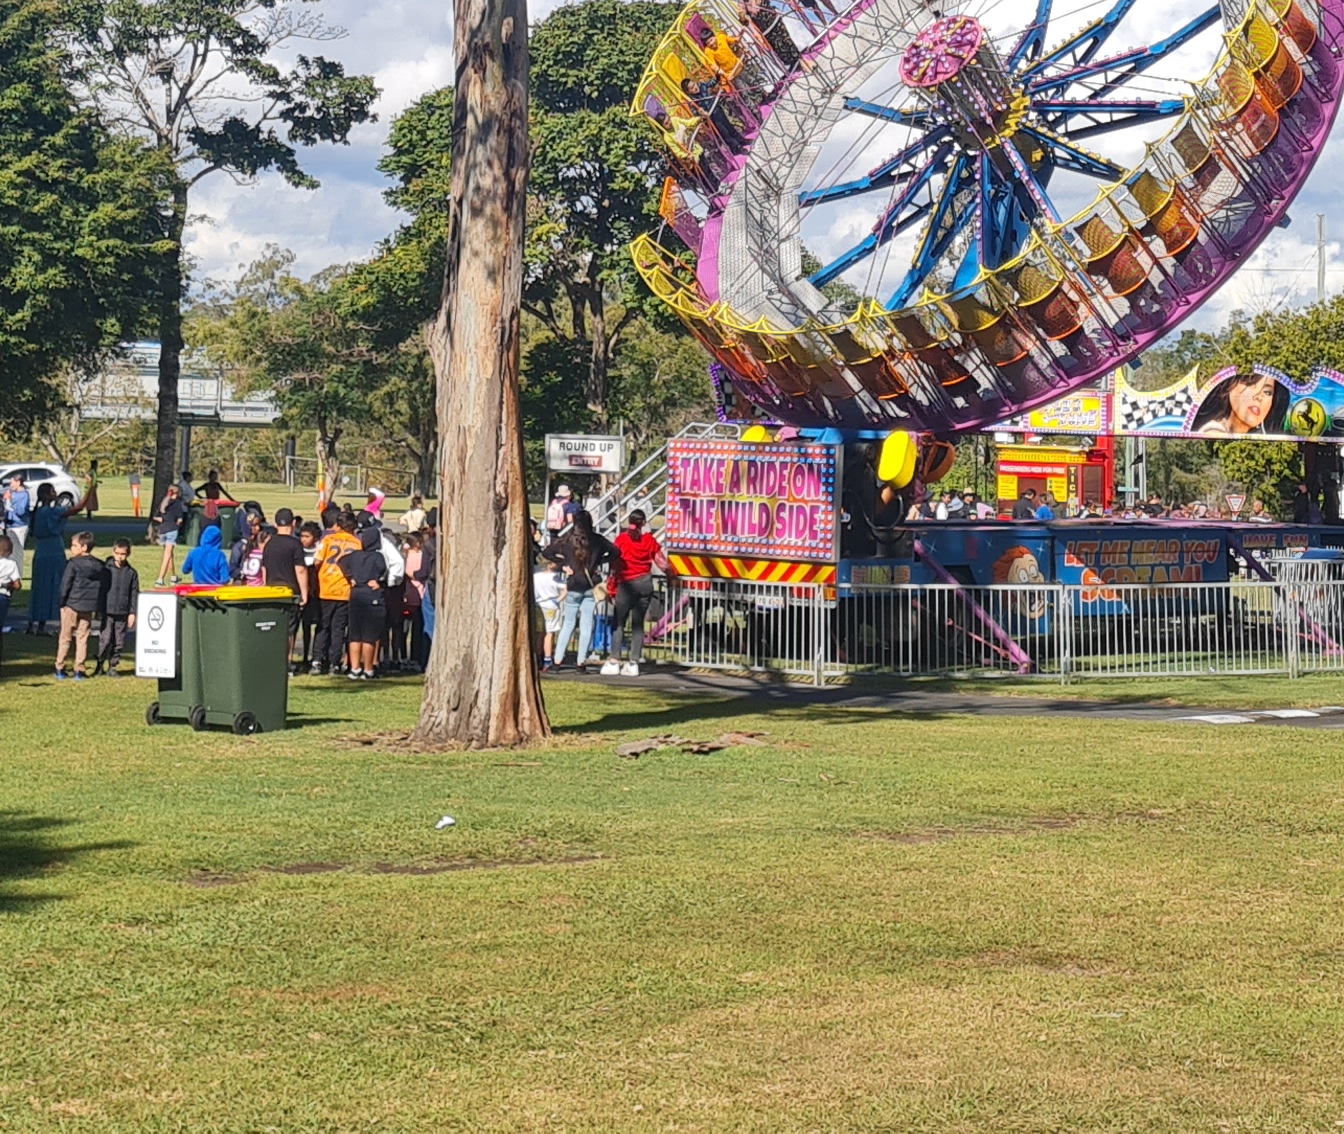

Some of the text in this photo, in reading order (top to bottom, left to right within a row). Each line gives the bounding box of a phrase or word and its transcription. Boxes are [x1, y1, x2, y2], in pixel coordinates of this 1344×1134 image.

[559, 442, 614, 453] ROUND UP
[570, 456, 601, 466] ENTRY
[679, 457, 824, 500] TAKE A RIDE ON
[679, 498, 822, 541] THE WILD SIDE
[1243, 534, 1309, 547] HAVE FUN
[1065, 539, 1221, 566] LET ME HEAR YOU
